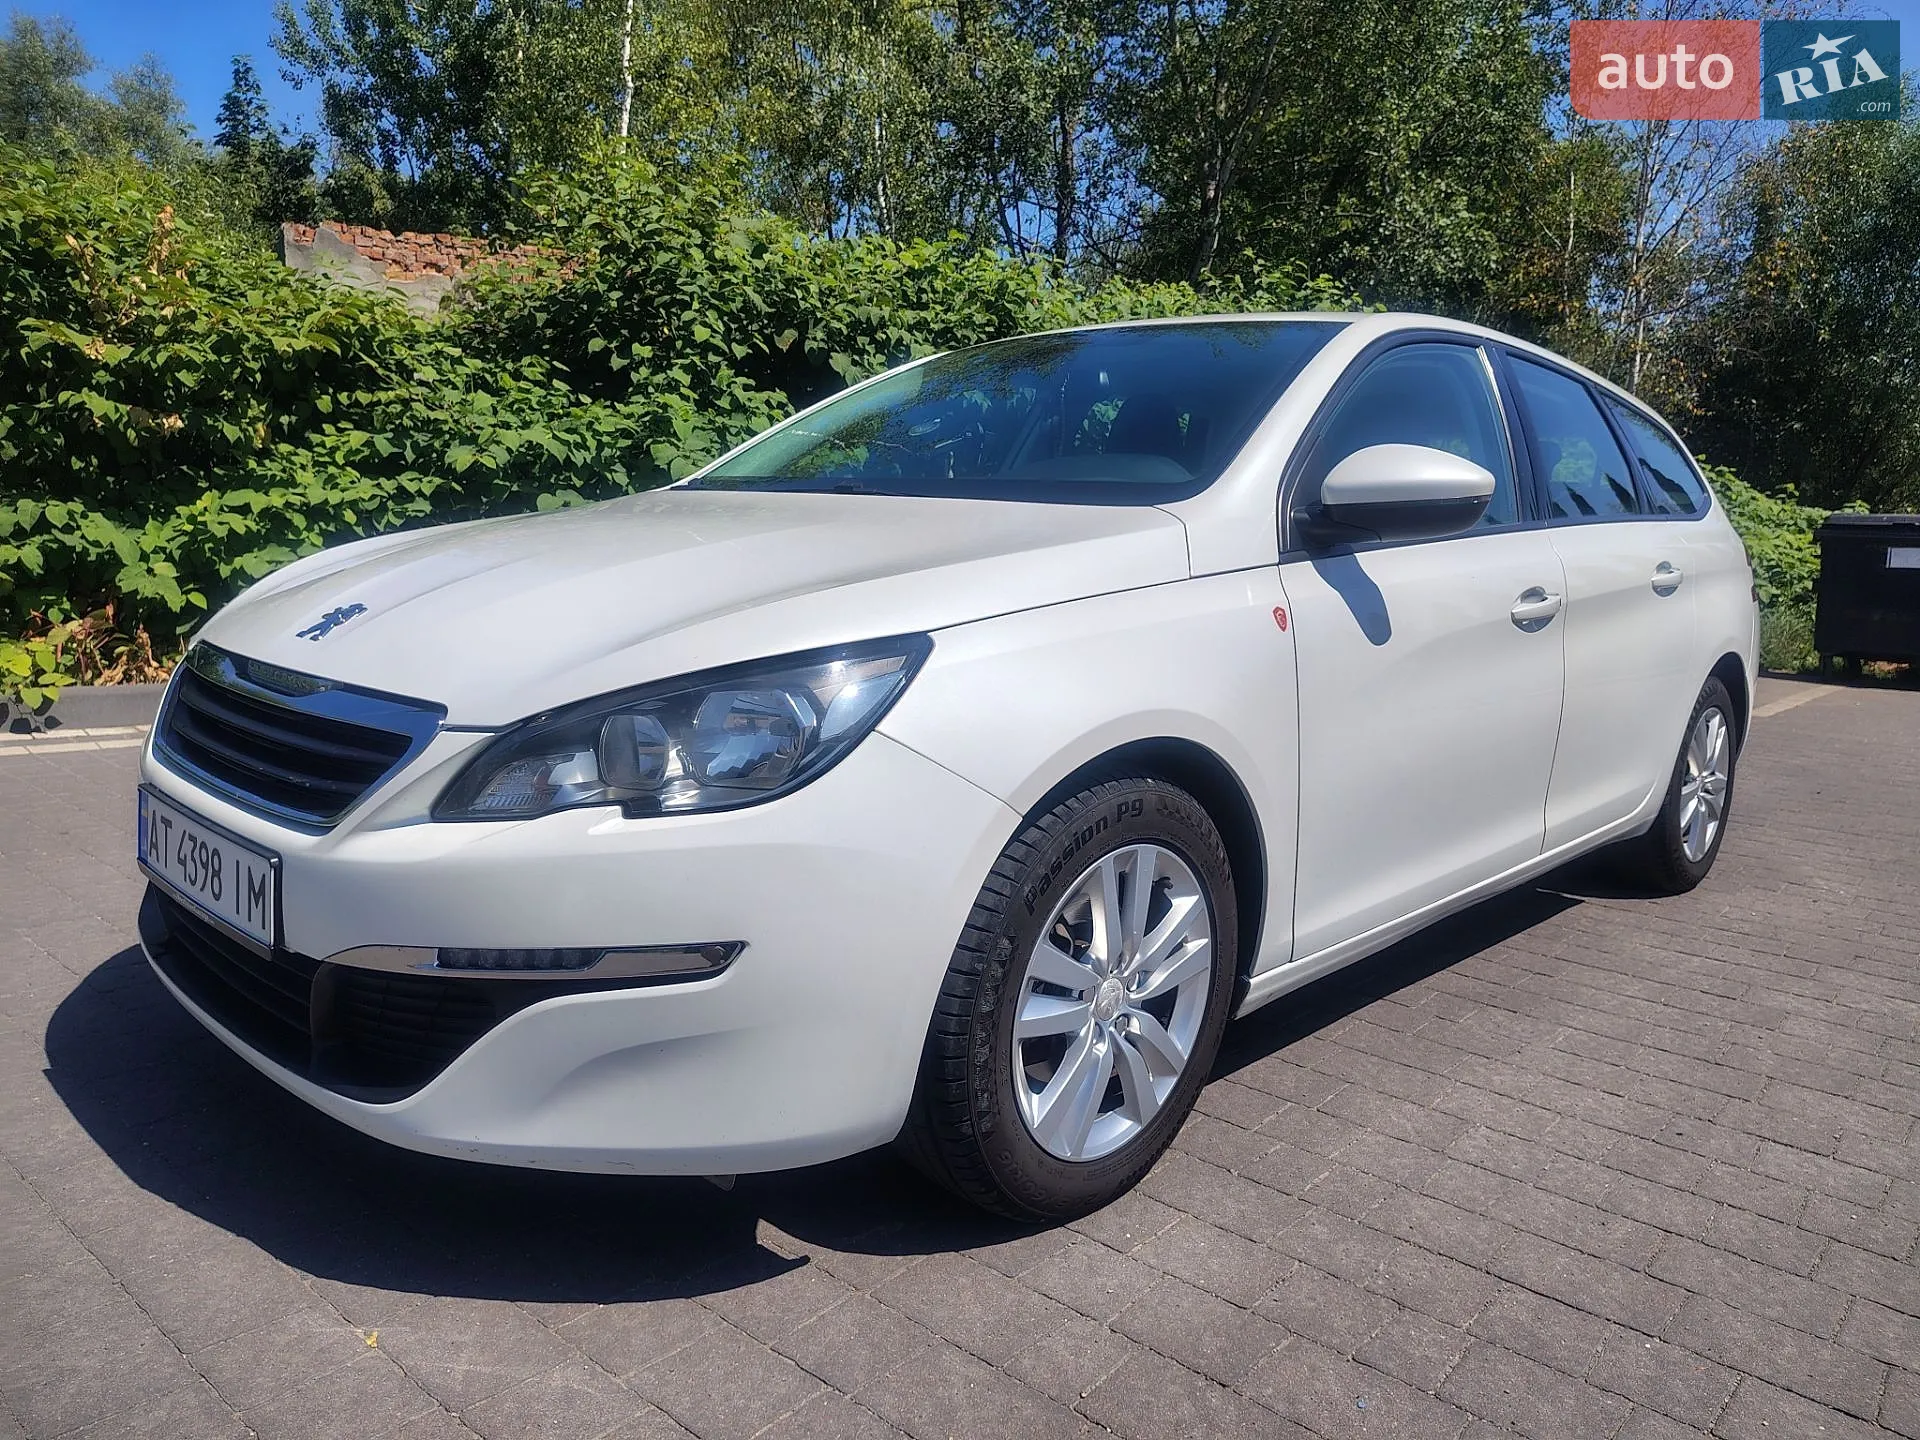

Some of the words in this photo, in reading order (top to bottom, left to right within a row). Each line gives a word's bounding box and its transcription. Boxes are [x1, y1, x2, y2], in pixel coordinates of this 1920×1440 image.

[149, 810, 173, 869] AT
[177, 829, 222, 902] 4398
[236, 860, 266, 930] IM
[1023, 815, 1109, 917] Passion
[1116, 798, 1144, 823] P9
